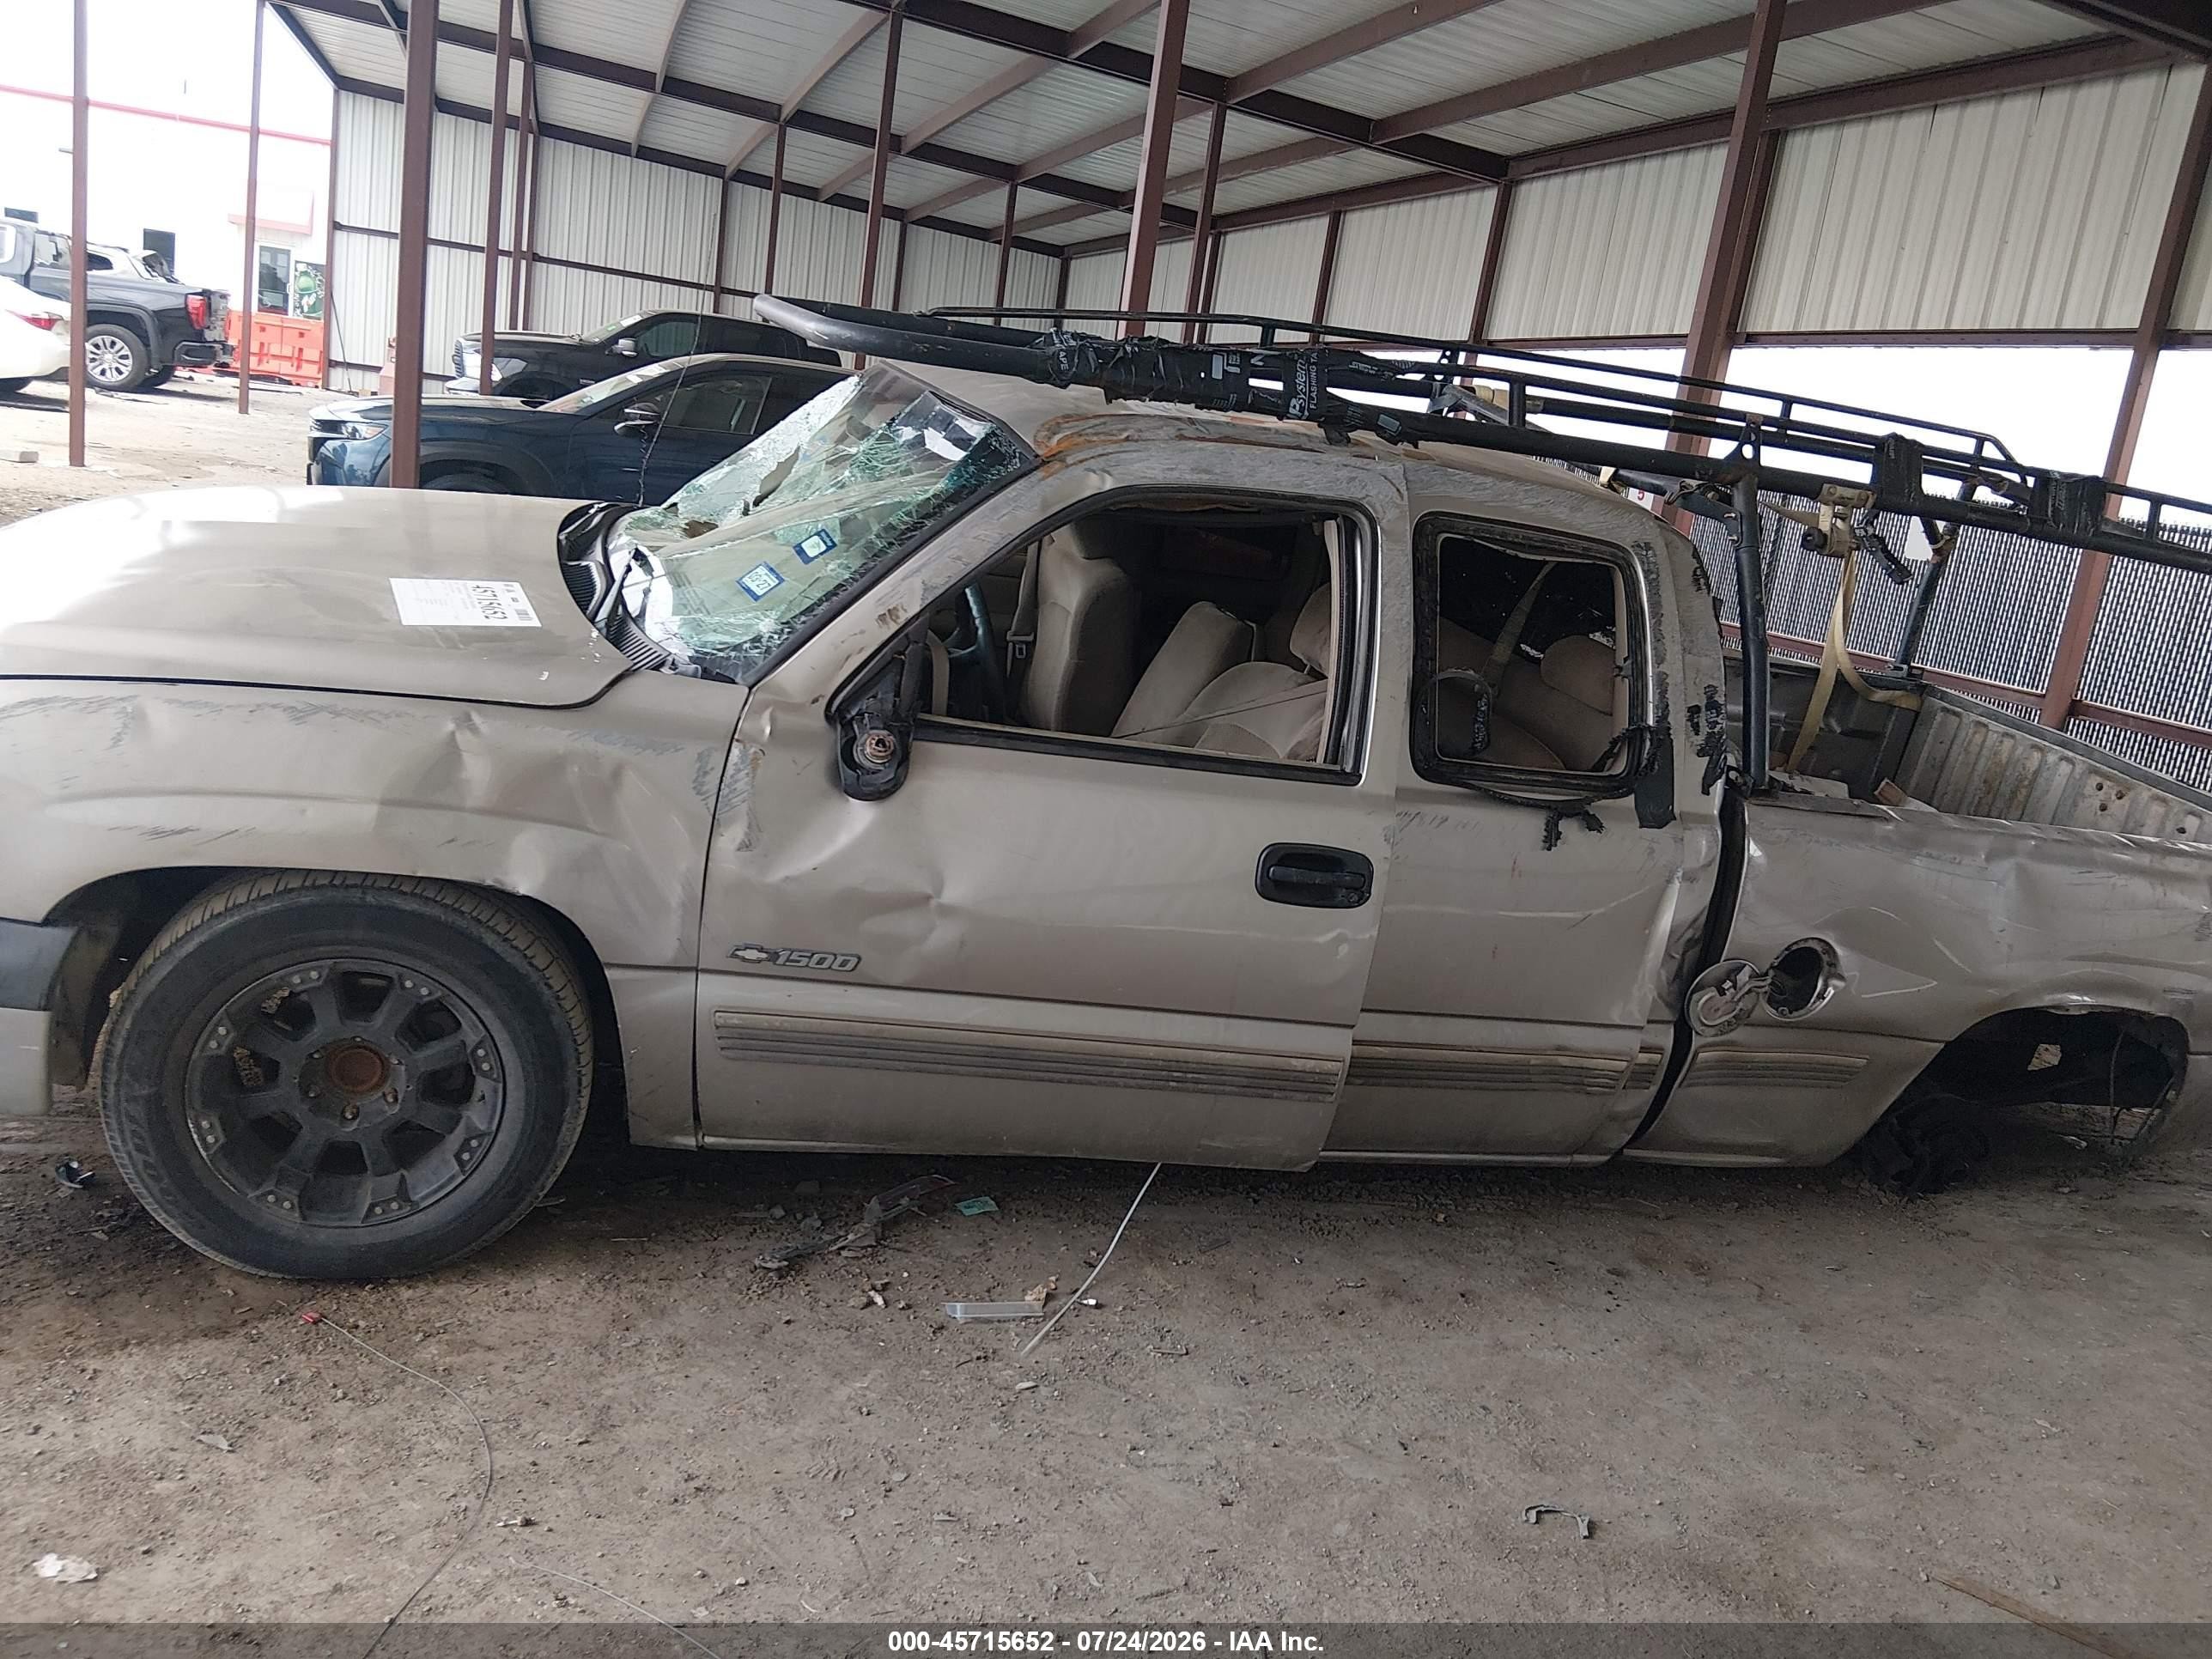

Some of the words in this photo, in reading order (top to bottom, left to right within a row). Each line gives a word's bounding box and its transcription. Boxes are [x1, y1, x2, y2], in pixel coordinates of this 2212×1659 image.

[1309, 365, 1317, 410] FLASHING
[471, 584, 509, 621] 45715652
[775, 948, 860, 972] 1500
